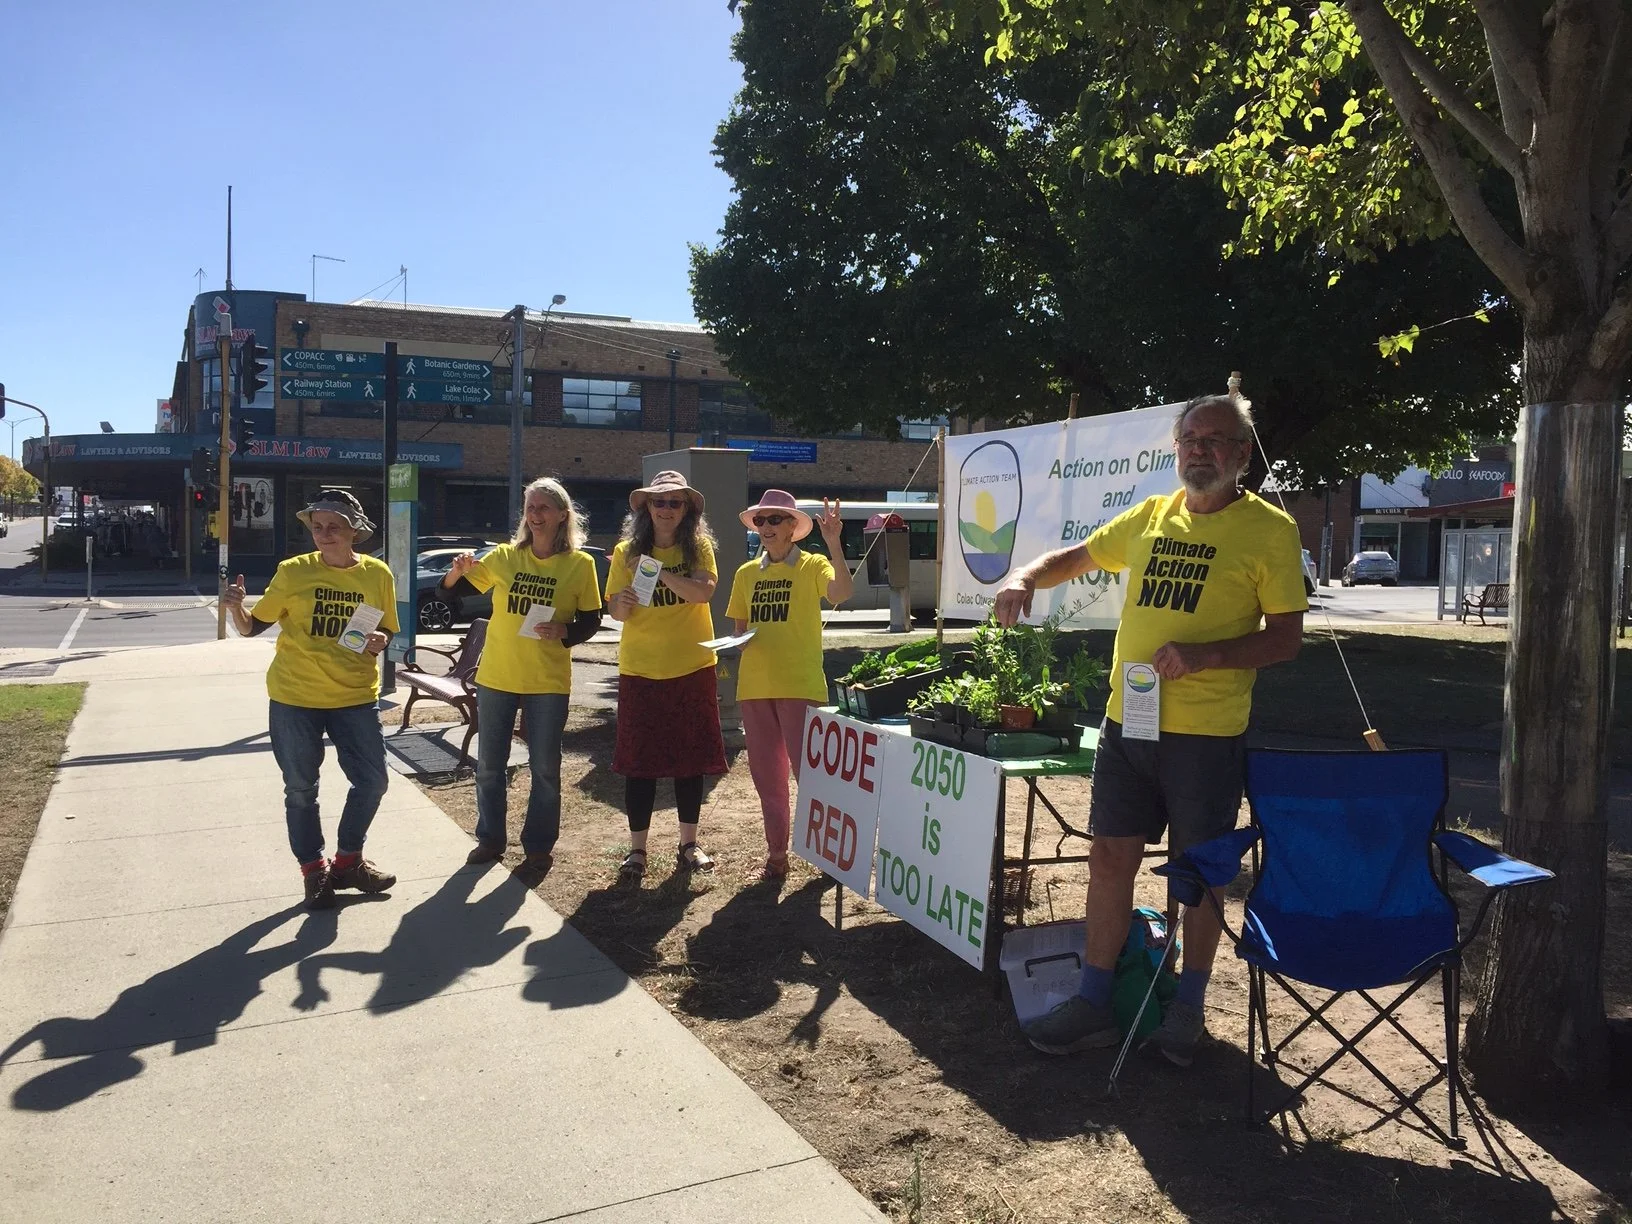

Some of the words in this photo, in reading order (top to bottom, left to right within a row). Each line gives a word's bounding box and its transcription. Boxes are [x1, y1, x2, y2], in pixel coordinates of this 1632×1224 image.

[294, 351, 325, 361] COPACC
[294, 362, 316, 371] 450m,
[317, 363, 336, 371] 6mins
[424, 359, 451, 369] Botanic
[451, 361, 481, 372] Gardens
[462, 372, 481, 380] 9mins
[294, 379, 324, 390] Railway
[324, 380, 352, 389] Station
[445, 384, 462, 394] Lake
[463, 386, 481, 395] Colac
[294, 389, 316, 398] 450m,
[316, 390, 336, 398] 6mins
[81, 447, 116, 456] LAWYERS
[125, 446, 171, 455] ADVISORS
[248, 440, 290, 456] SLM
[293, 441, 332, 458] Law
[338, 450, 383, 461] LAWYERS
[1048, 458, 1104, 480] Action
[1108, 457, 1130, 475] on
[1136, 449, 1177, 473] Clim
[980, 475, 999, 484] ACTION
[1001, 473, 1017, 482] TEAM
[1437, 470, 1463, 480] POLLO
[1469, 470, 1506, 481] SEAFOODS
[1102, 485, 1136, 509] and
[1151, 537, 1217, 560] Climate
[1144, 556, 1210, 582] Action
[514, 572, 557, 586] Climate
[754, 579, 793, 590] Climate
[315, 588, 364, 603] Climate
[509, 582, 554, 599] Action
[653, 588, 689, 607] NO
[751, 589, 790, 603] Action
[1136, 579, 1205, 614] NOW
[507, 595, 552, 616] NO
[956, 592, 974, 605] Colac
[313, 601, 357, 617] Actio
[750, 603, 790, 622] NOW
[806, 715, 878, 794] CODE
[911, 741, 966, 801] 2050
[806, 798, 858, 872] RED
[922, 802, 941, 856] is
[879, 848, 921, 906] TOO
[926, 874, 984, 949] LATE
